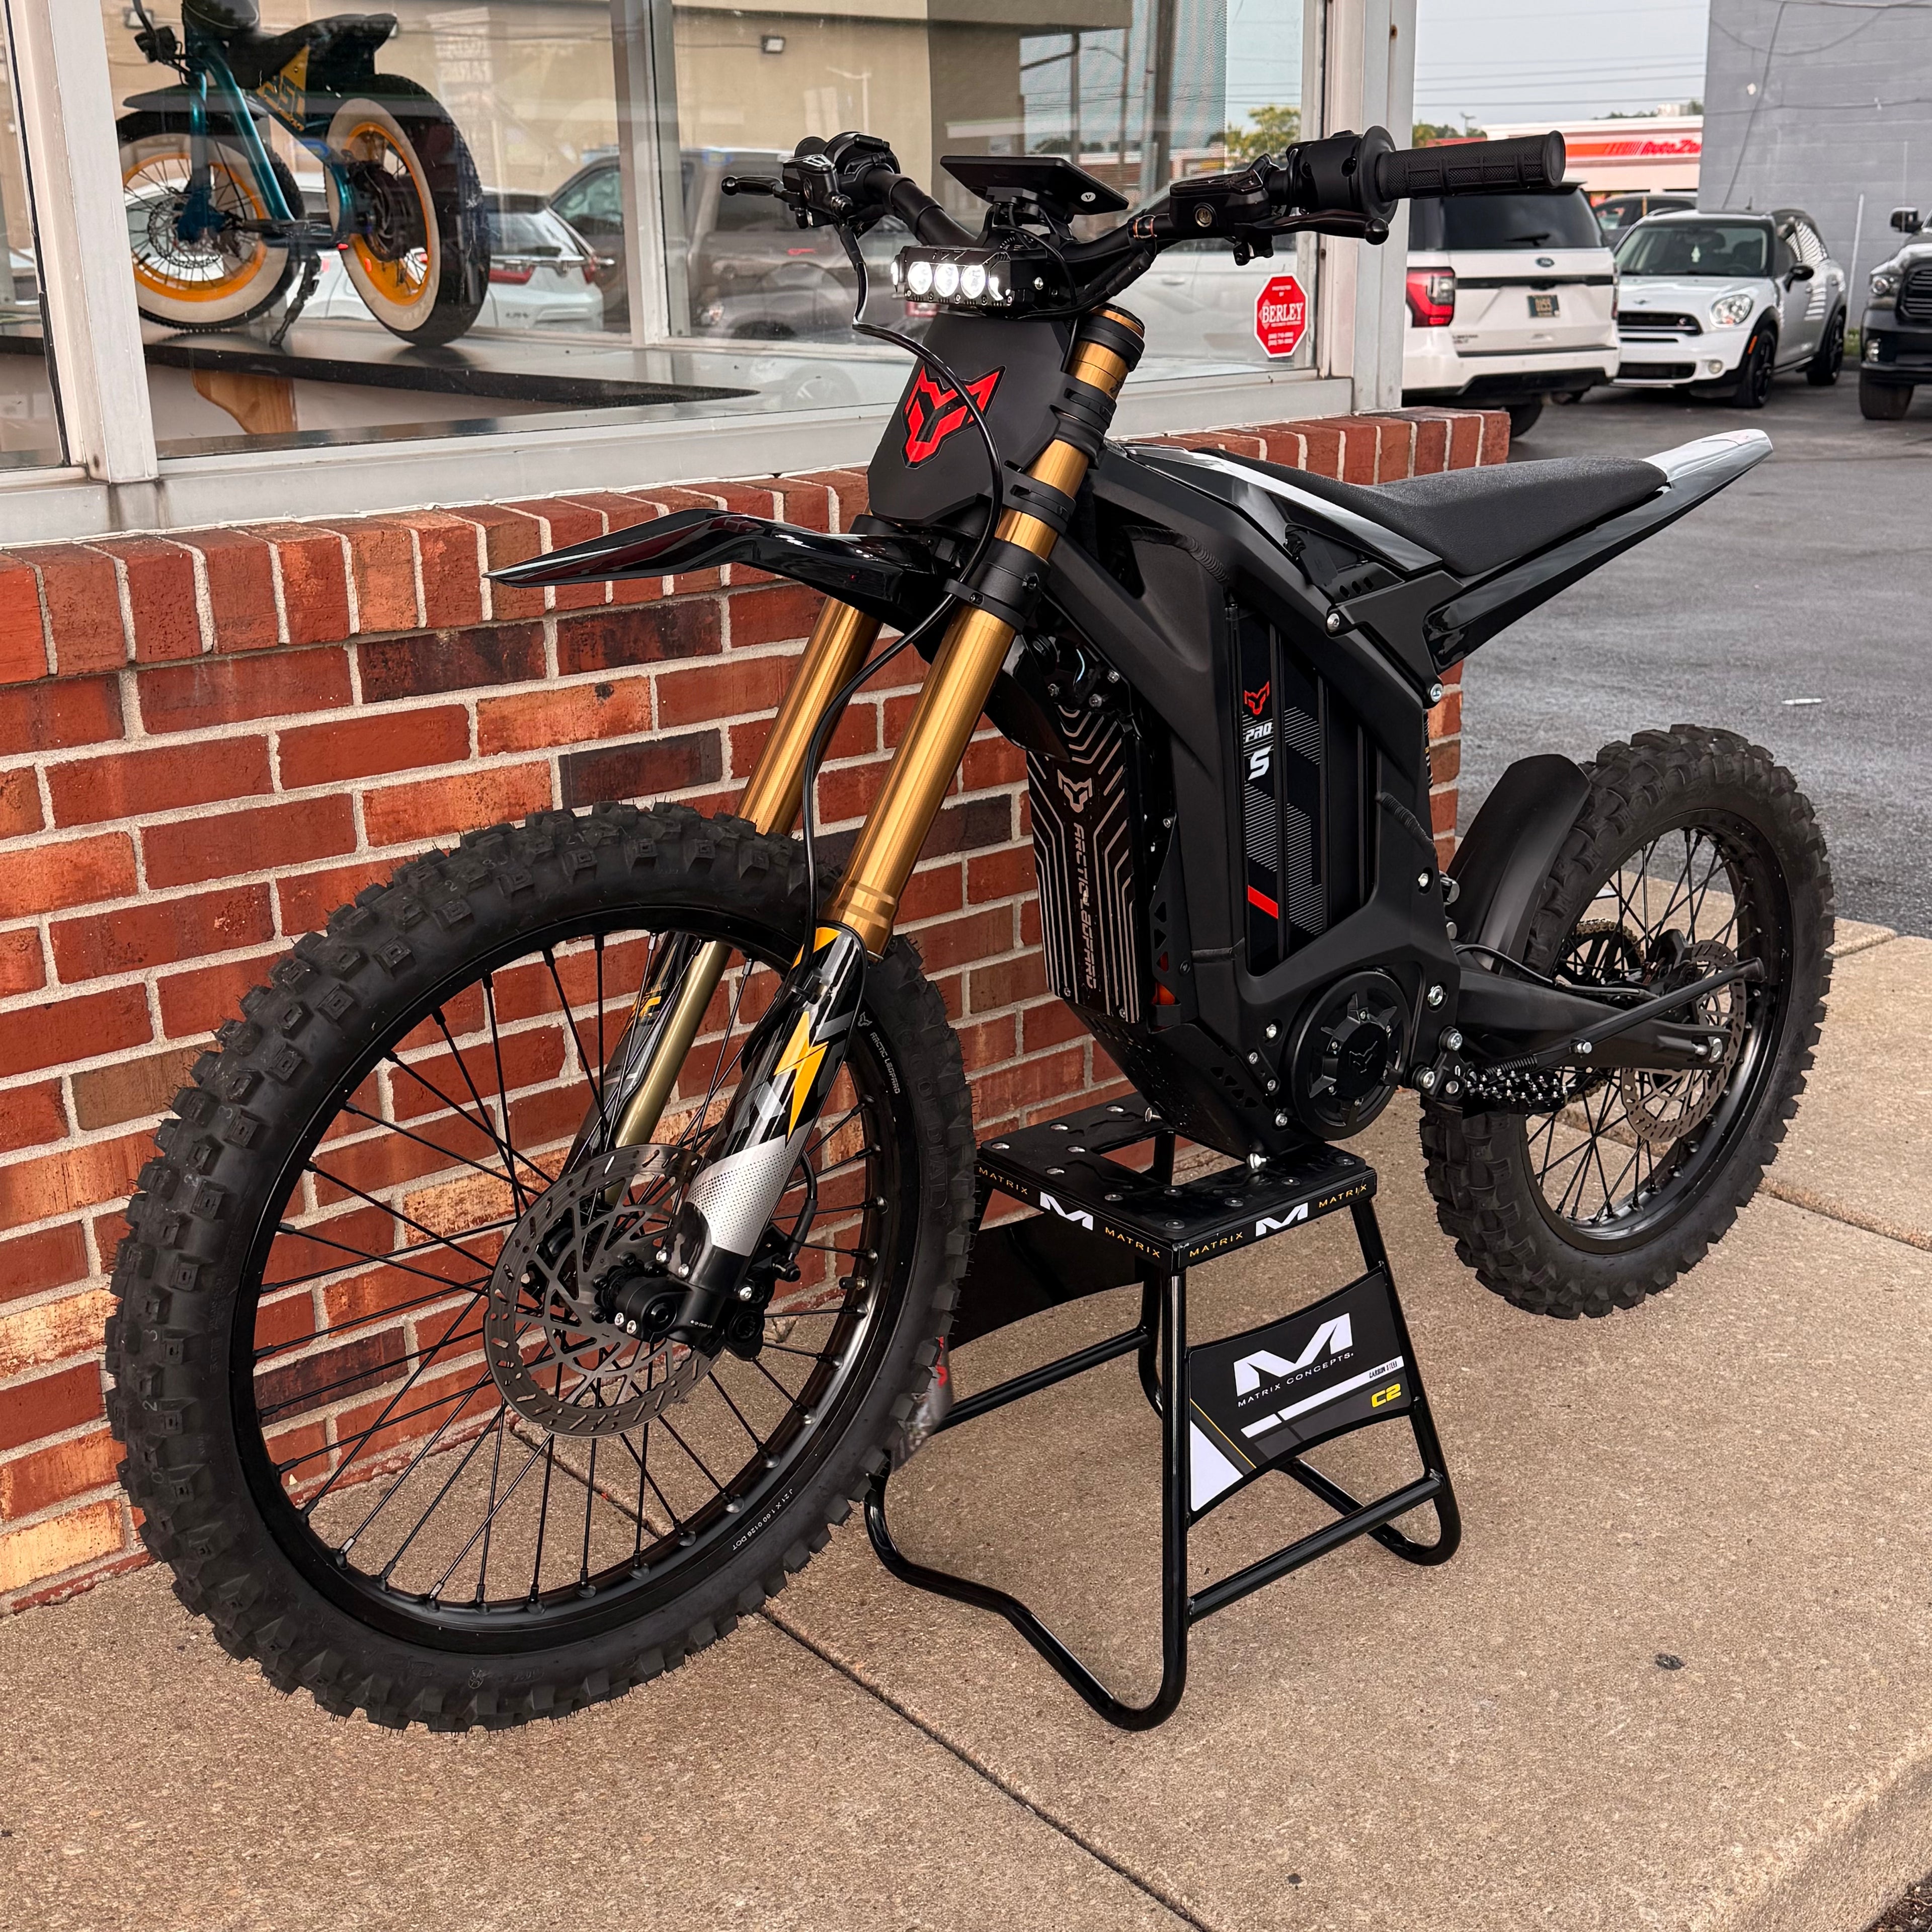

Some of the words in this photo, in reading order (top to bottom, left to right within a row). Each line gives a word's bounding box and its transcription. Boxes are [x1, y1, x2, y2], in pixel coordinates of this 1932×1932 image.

[1261, 302, 1304, 323] BERLEY
[1245, 722, 1272, 743] PRO
[1248, 745, 1272, 780] S
[870, 1032, 888, 1058] ARCTIC
[884, 1058, 900, 1094] LEOPARD
[979, 1167, 1028, 1195] MATRIX
[1105, 1227, 1160, 1258] MATRIX
[1189, 1232, 1243, 1257] MATRIX
[1319, 1184, 1367, 1208] MATRIX
[1238, 1383, 1281, 1407] MATRIX
[1371, 1383, 1402, 1408] C2
[781, 1493, 790, 1502] 21
[733, 1536, 747, 1550] DOT
